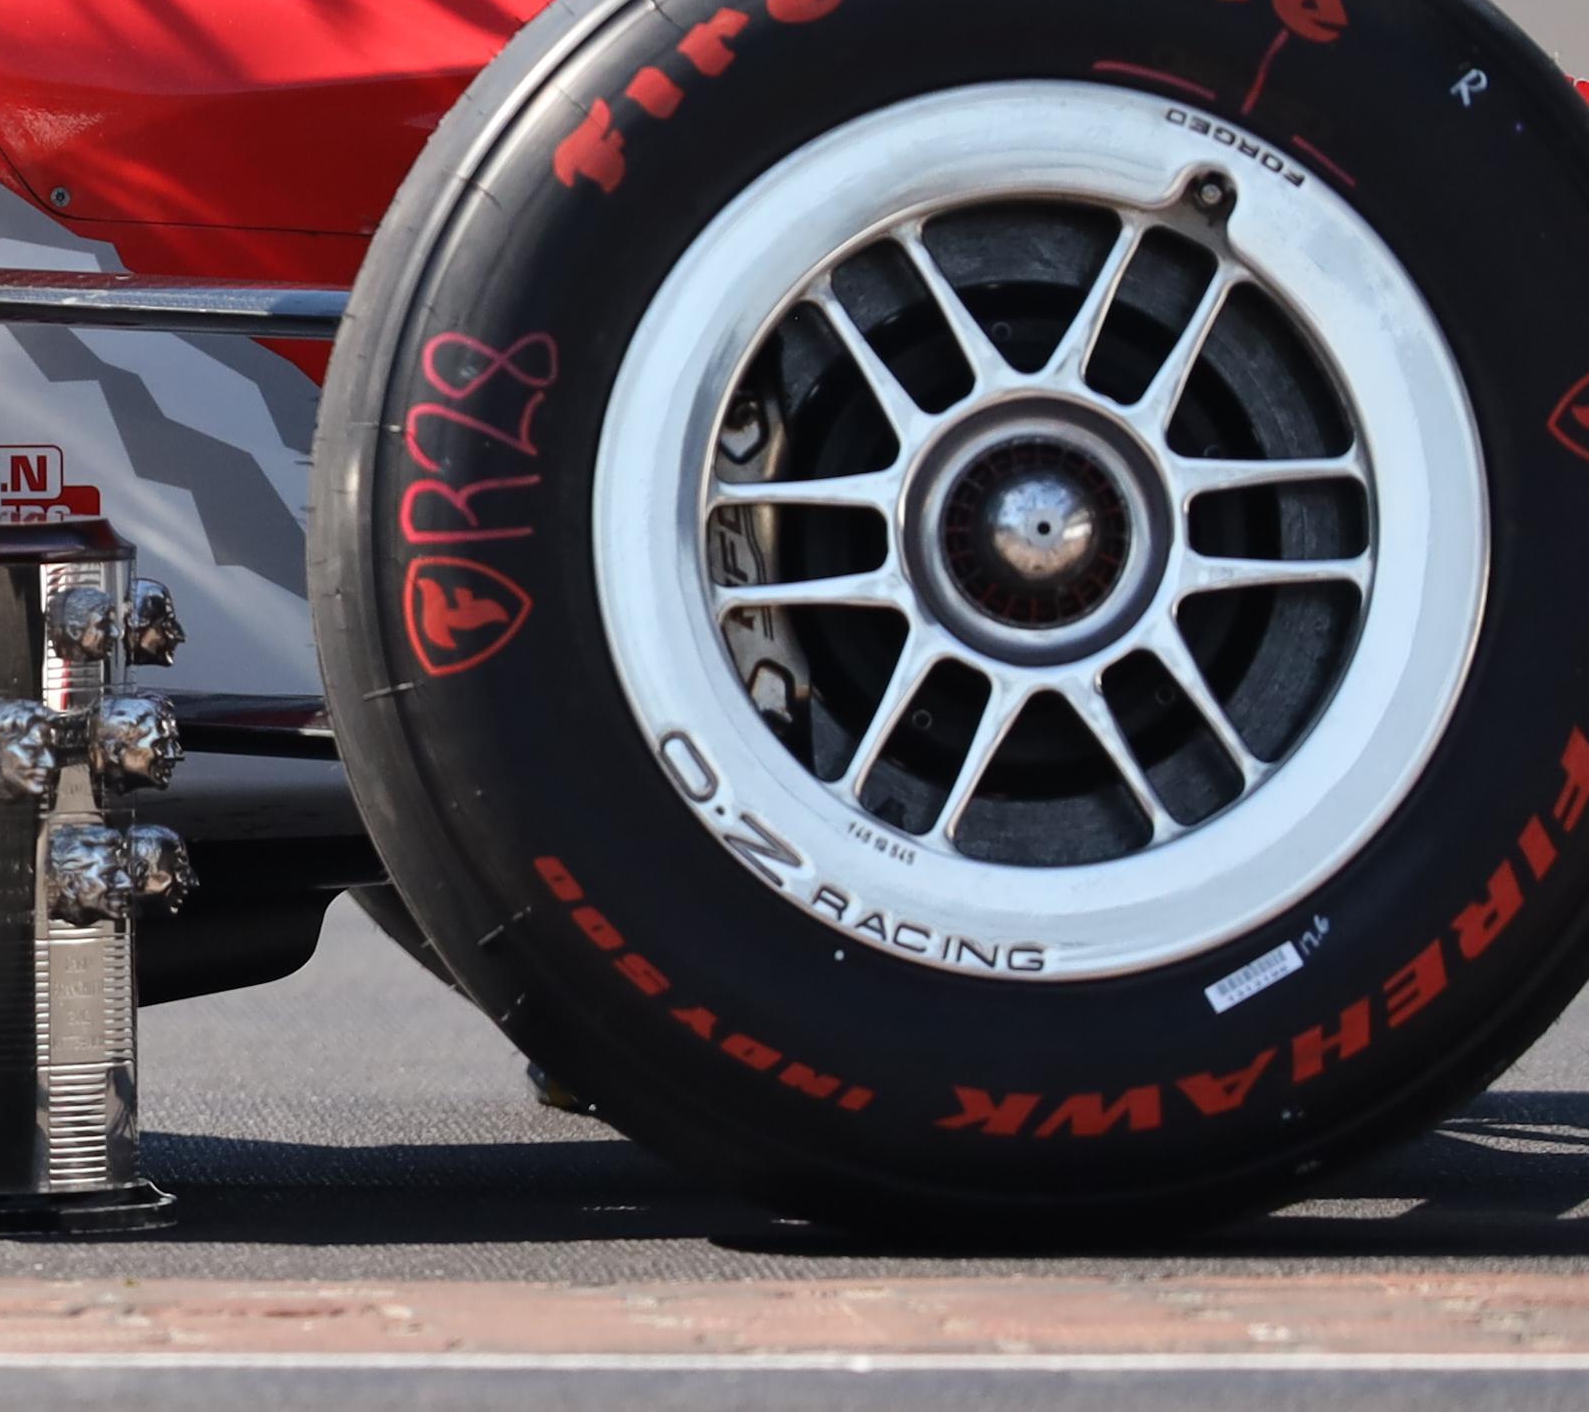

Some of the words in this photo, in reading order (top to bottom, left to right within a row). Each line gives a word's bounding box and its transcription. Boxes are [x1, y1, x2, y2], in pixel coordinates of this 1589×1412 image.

[1449, 67, 1488, 107] R
[1164, 107, 1308, 187] FORGED
[534, 856, 671, 996] 500
[811, 886, 1047, 974] RACING
[934, 723, 1589, 1138] FIREHAWK
[670, 1001, 873, 1111] INDY
